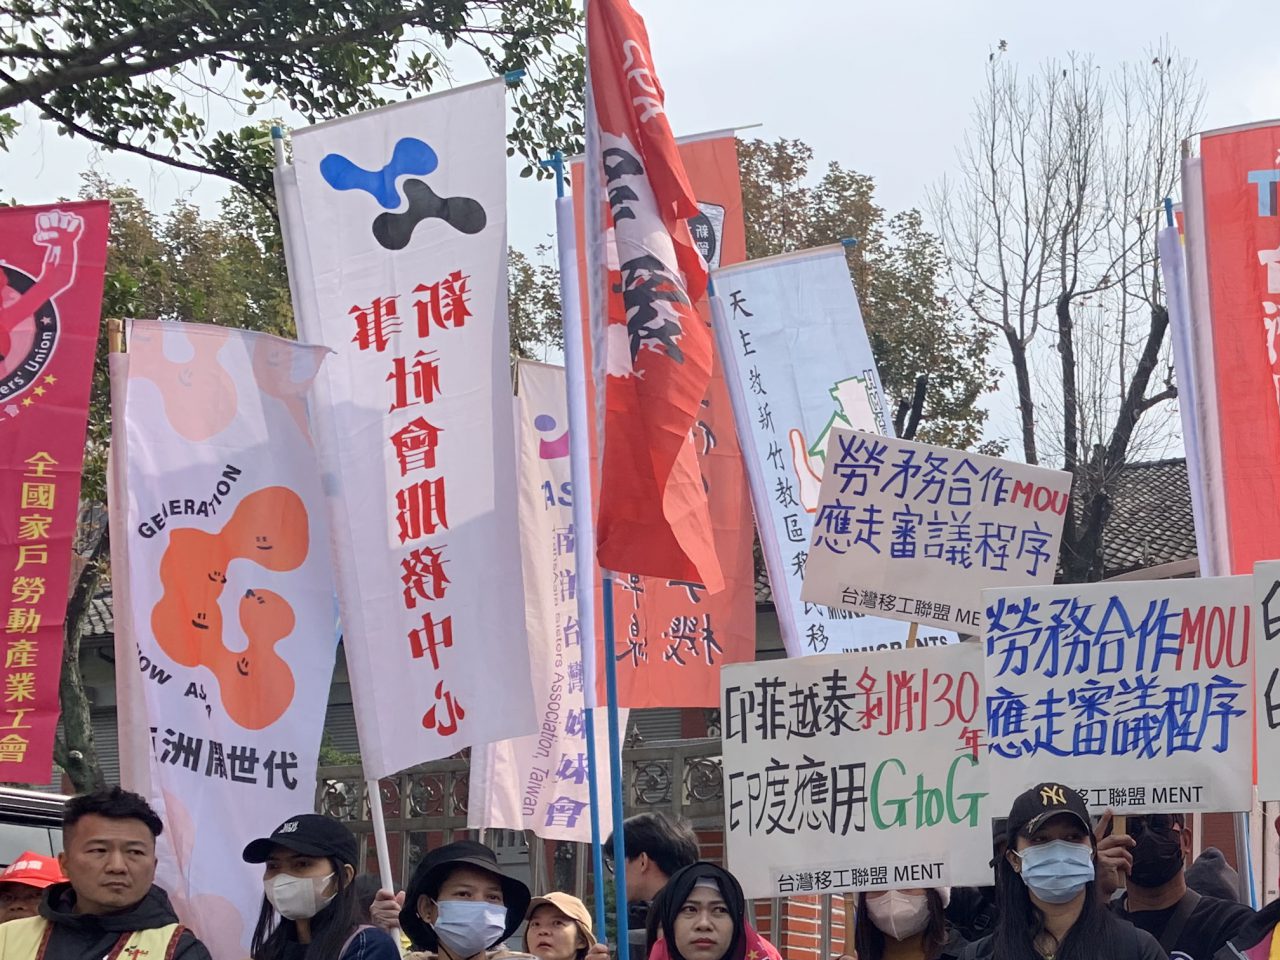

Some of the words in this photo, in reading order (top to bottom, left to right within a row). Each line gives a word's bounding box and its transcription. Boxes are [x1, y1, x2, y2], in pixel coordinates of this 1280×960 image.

[24, 330, 52, 373] Union
[814, 498, 1053, 577] 應走審議程序
[0, 451, 58, 763] 全國家戶勞動產業工會
[840, 586, 952, 622] 台灣移工聯盟
[532, 671, 565, 759] Association,
[985, 674, 1248, 760] 應走審議程序
[521, 765, 550, 818] Taiwan
[1151, 785, 1204, 805] MENT
[776, 866, 888, 893] 台灣移工聯盟
[893, 862, 945, 883] MENT
